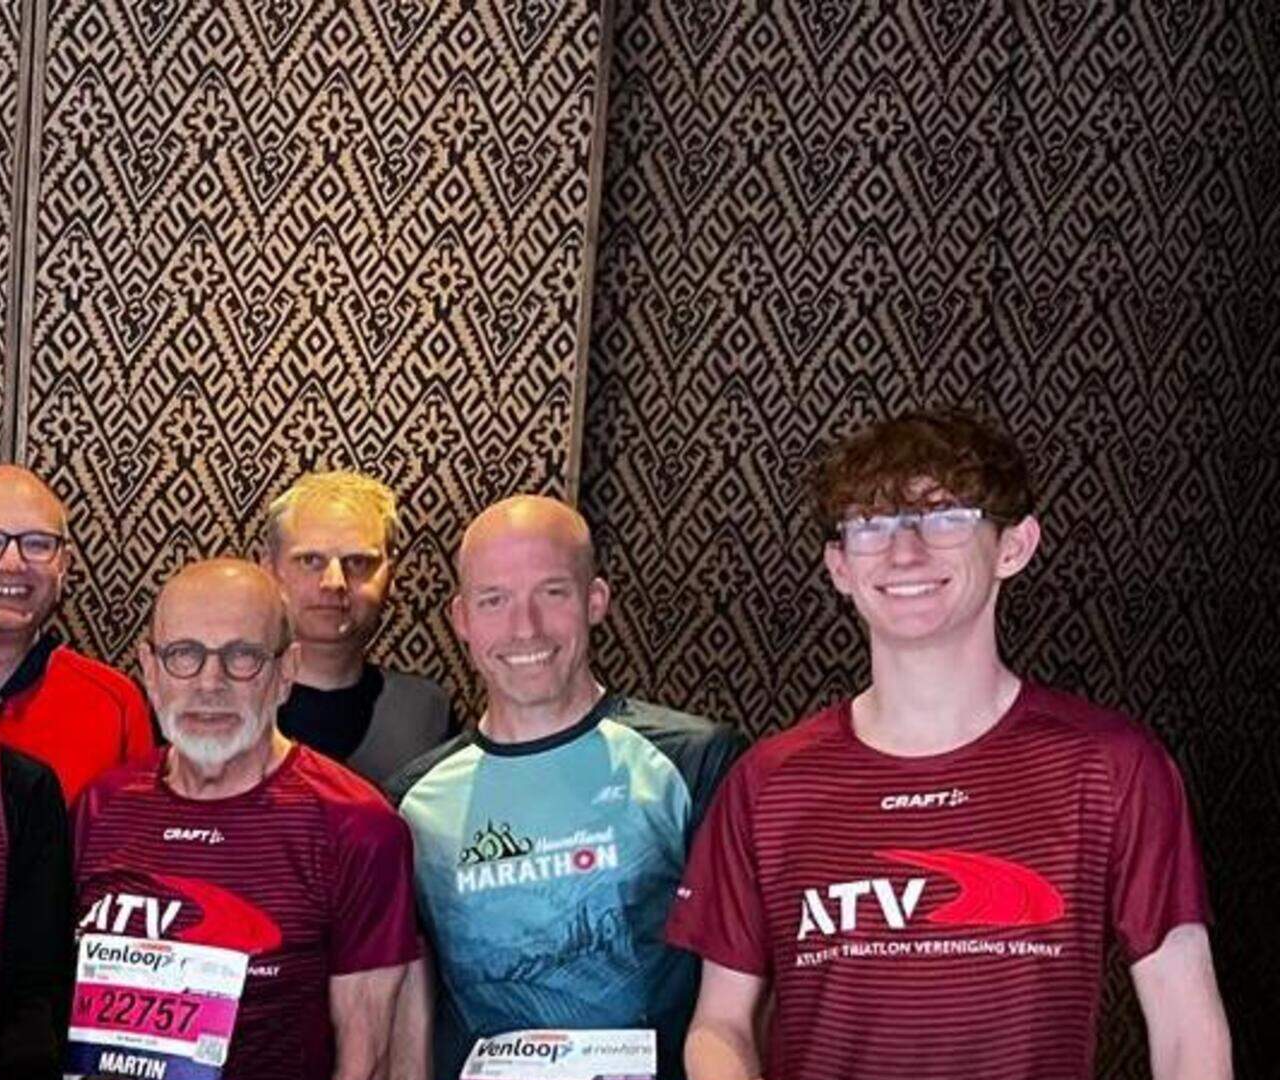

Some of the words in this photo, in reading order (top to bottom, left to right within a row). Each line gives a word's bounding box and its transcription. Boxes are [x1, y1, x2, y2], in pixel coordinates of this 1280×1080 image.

[880, 791, 950, 810] CRAFT
[163, 828, 210, 843] CRAFT
[456, 844, 618, 894] MARATHON
[79, 892, 183, 940] ATV
[797, 878, 927, 941] ATV
[86, 942, 176, 970] Venloop
[842, 941, 910, 957] TRIATLON
[913, 940, 1006, 955] VERENIGING
[96, 990, 201, 1033] 22757
[98, 1051, 168, 1080] MARTIN
[478, 1039, 573, 1064] Venloop
